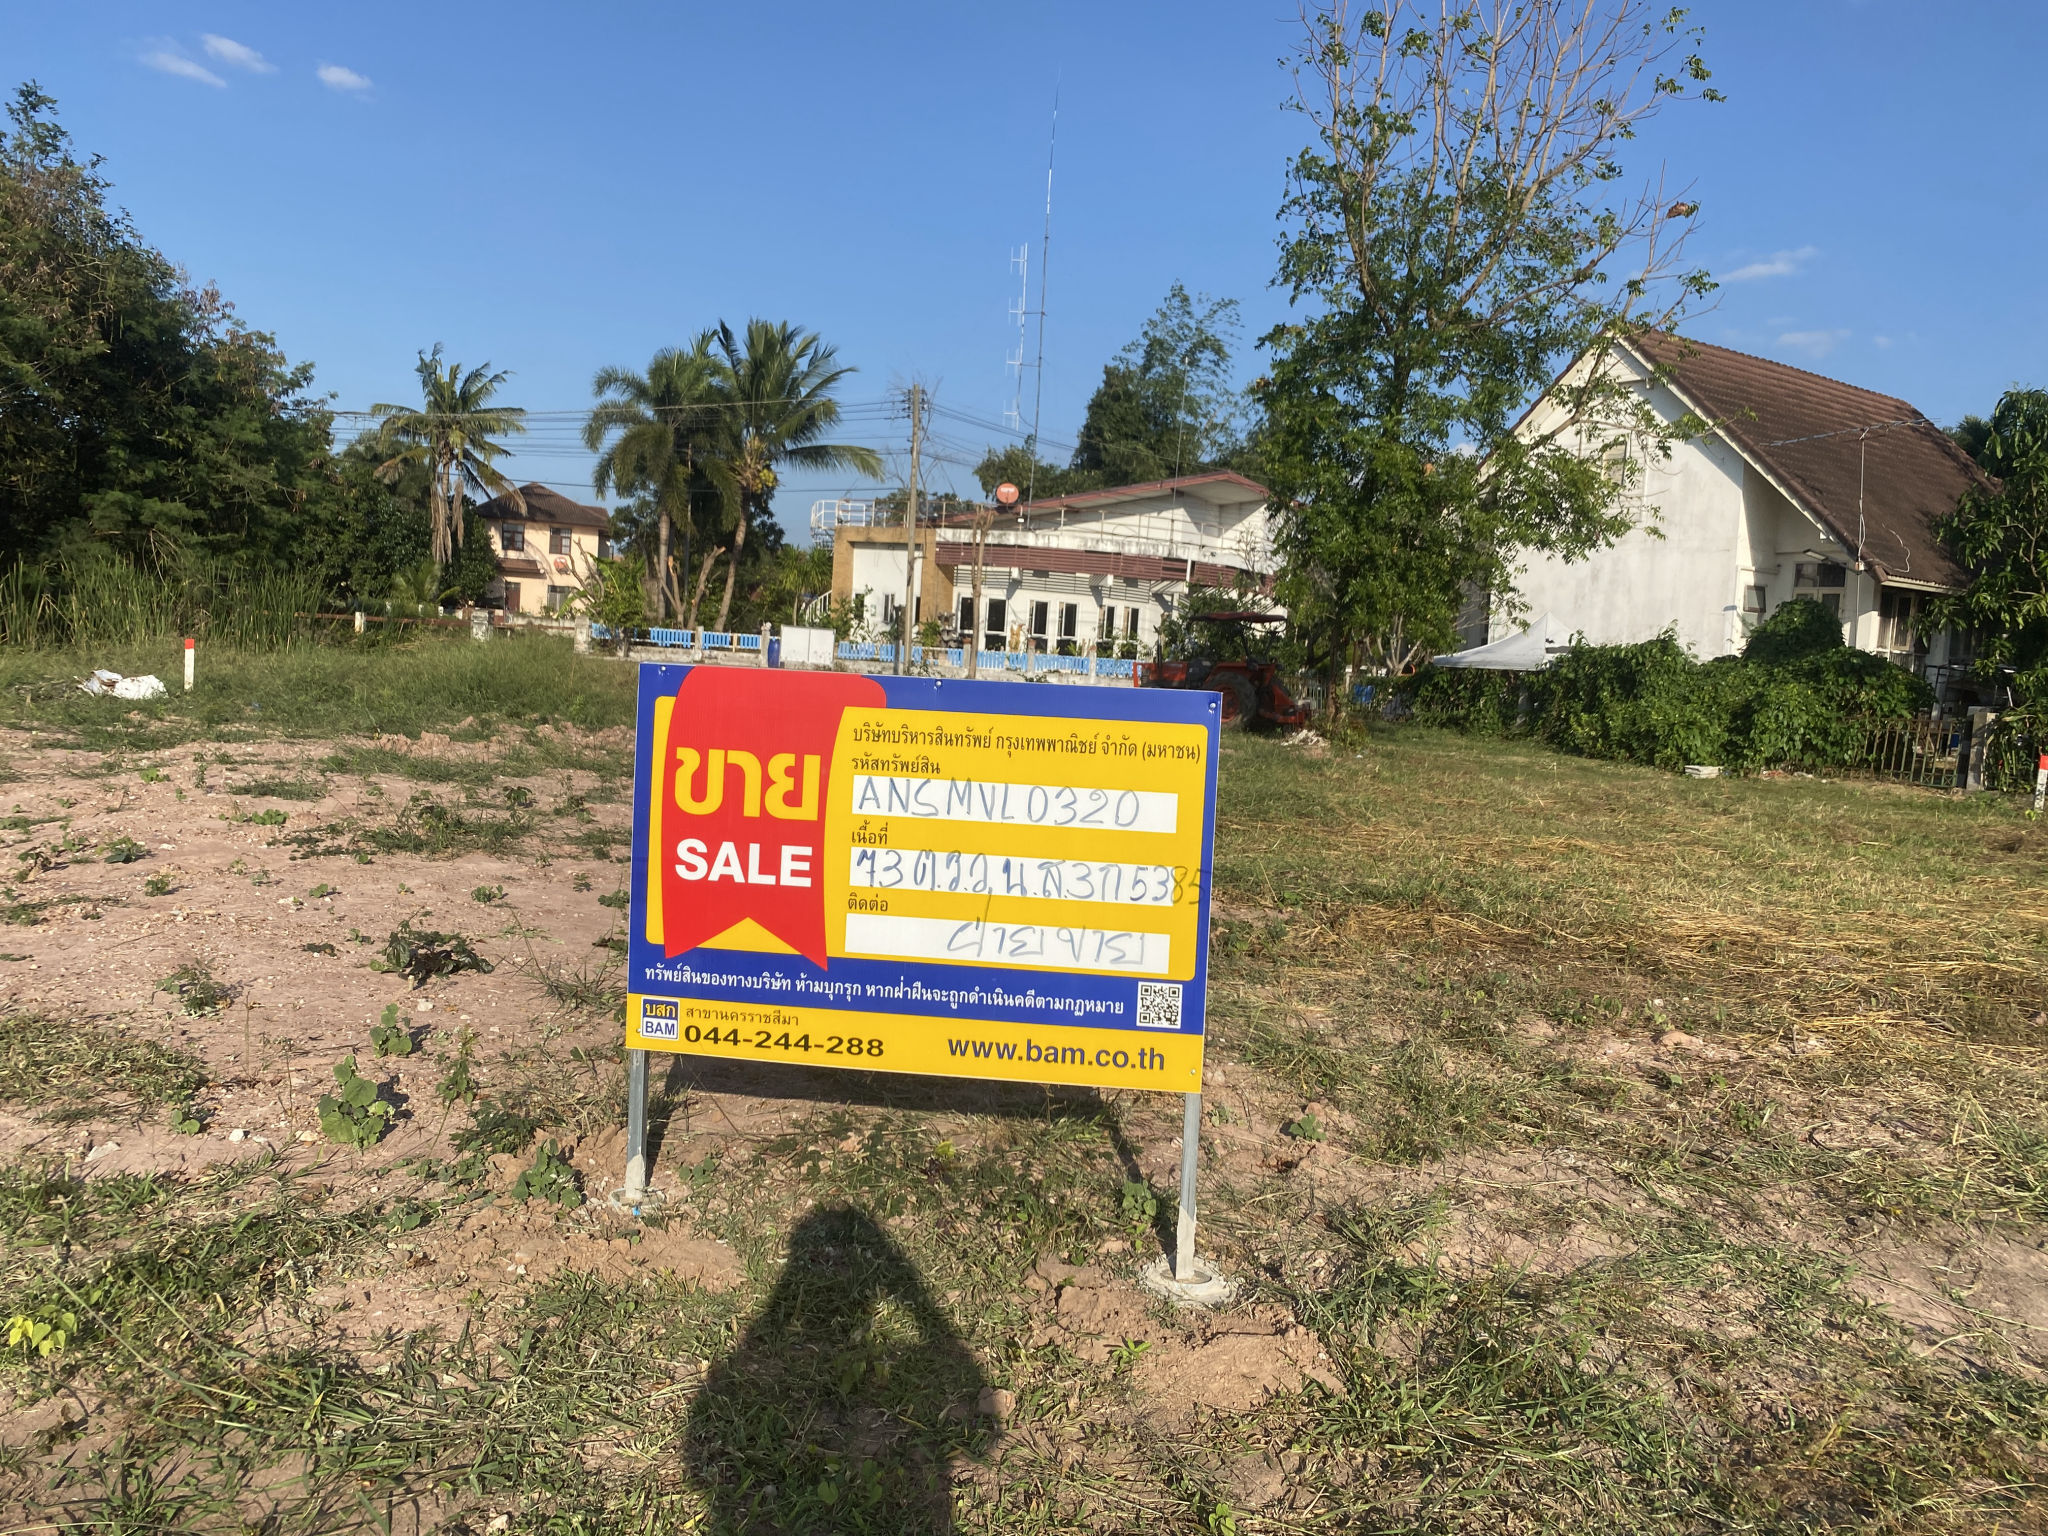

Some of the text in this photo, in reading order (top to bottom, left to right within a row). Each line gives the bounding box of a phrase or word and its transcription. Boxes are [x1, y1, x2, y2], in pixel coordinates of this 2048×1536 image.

[1101, 734, 1138, 757] จำกัด
[1142, 741, 1201, 764] (มหาชน)
[851, 752, 941, 774] รหัสทรัพย์สิน
[674, 746, 821, 821] ขาย
[851, 820, 888, 845] เนื้อที่
[675, 838, 813, 887] SALE
[848, 891, 888, 912] ติดต่อ
[645, 963, 791, 991] ทรัพย์สินของทางบริษัท
[795, 972, 862, 1002] ห้ามบุกรุก
[645, 1003, 676, 1018] บสก
[686, 1007, 799, 1026] สาขานครราชสีมา
[645, 1021, 676, 1036] BAM
[684, 1025, 884, 1057] 044-244-288
[948, 1038, 1165, 1070] www.bam.co.th
